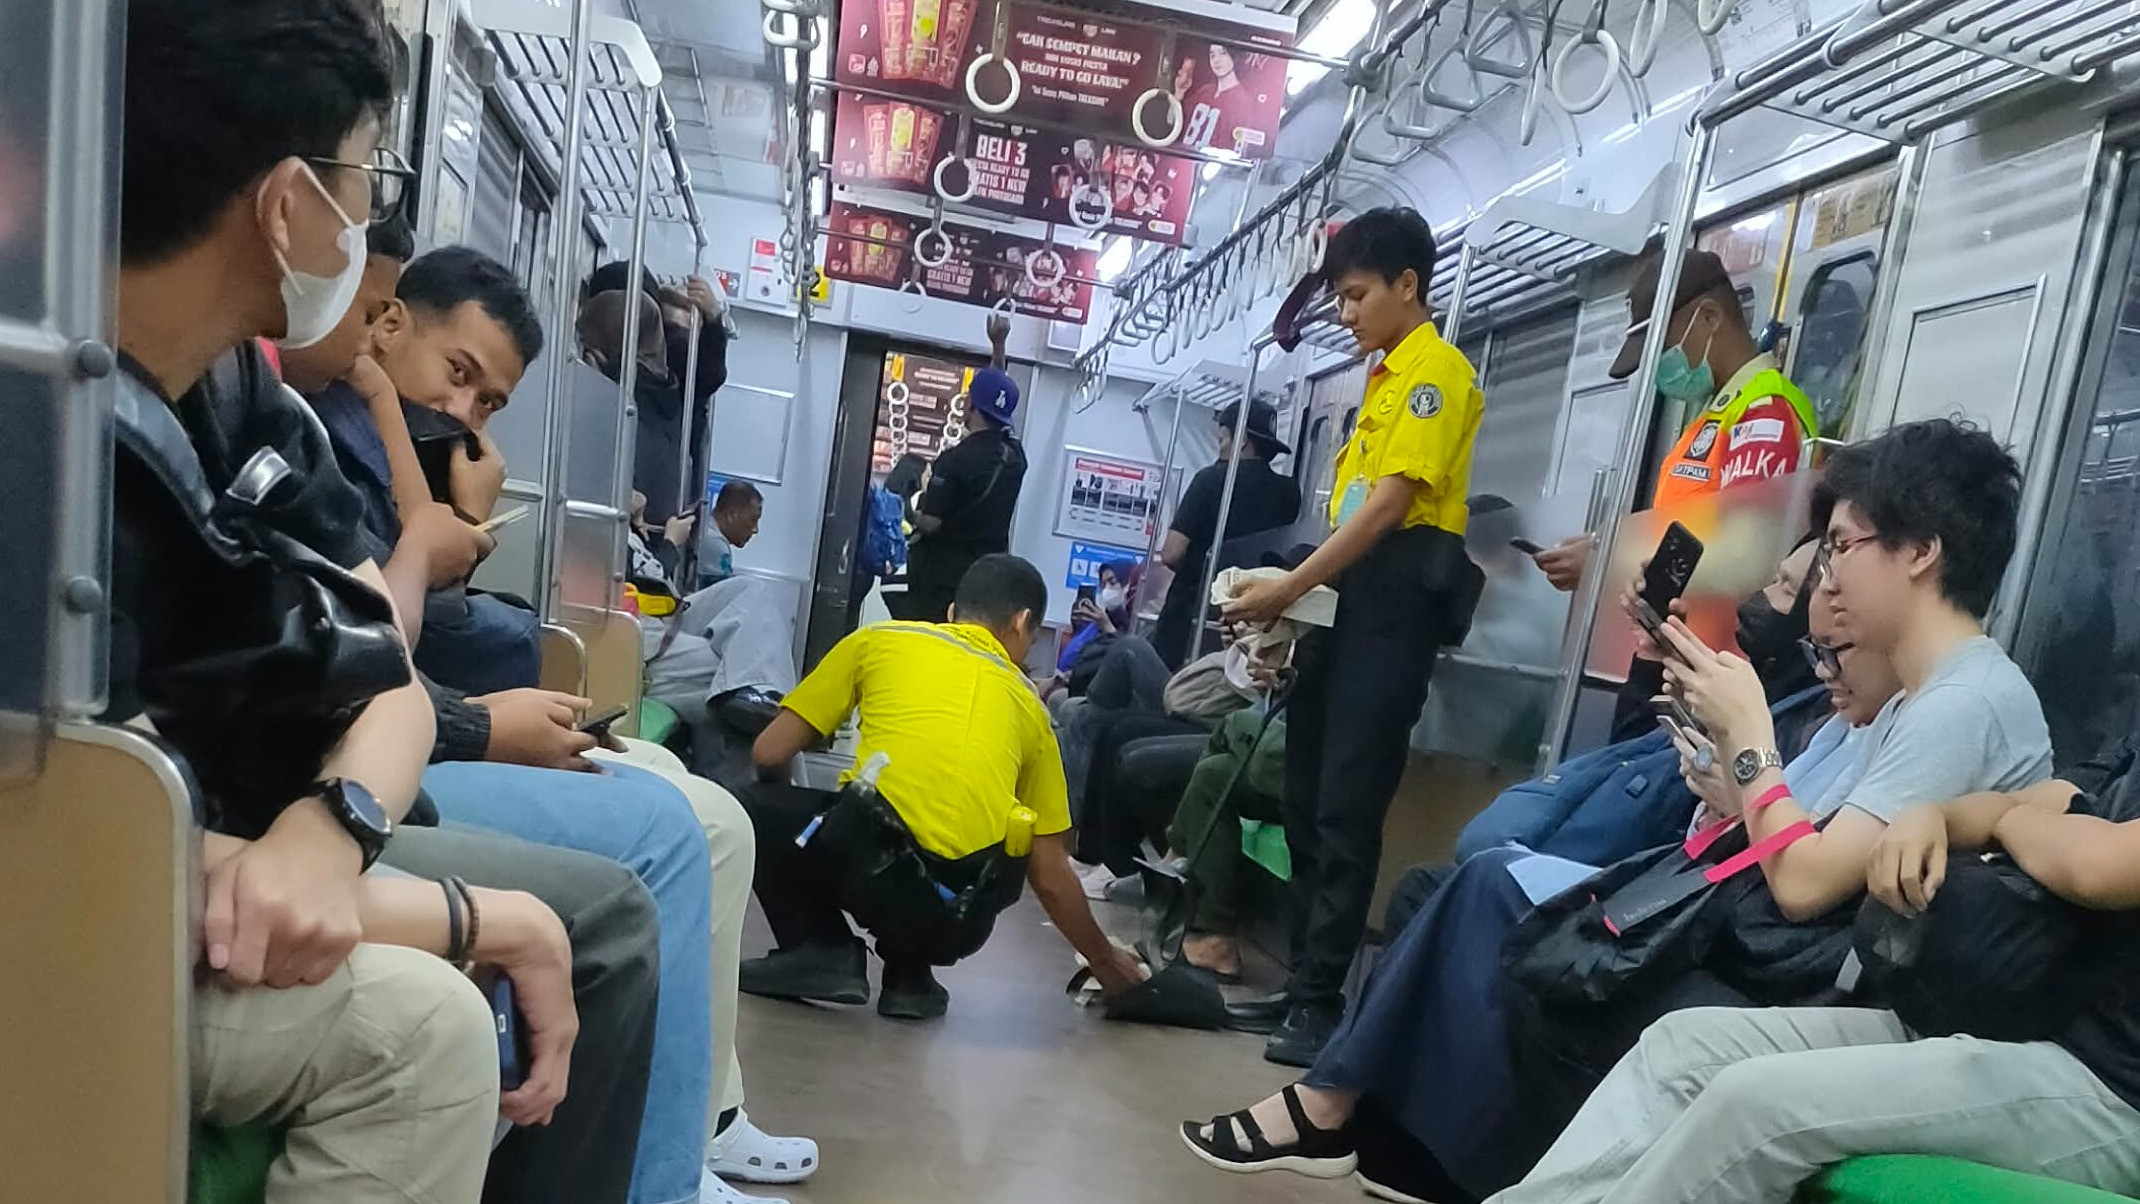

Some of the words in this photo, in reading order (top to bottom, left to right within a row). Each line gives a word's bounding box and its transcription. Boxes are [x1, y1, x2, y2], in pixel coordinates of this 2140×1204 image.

[1021, 60, 1060, 78] READY
[1060, 68, 1075, 80] TO
[1076, 71, 1091, 84] GO
[976, 134, 1012, 162] BELI
[1014, 142, 1028, 166] 3
